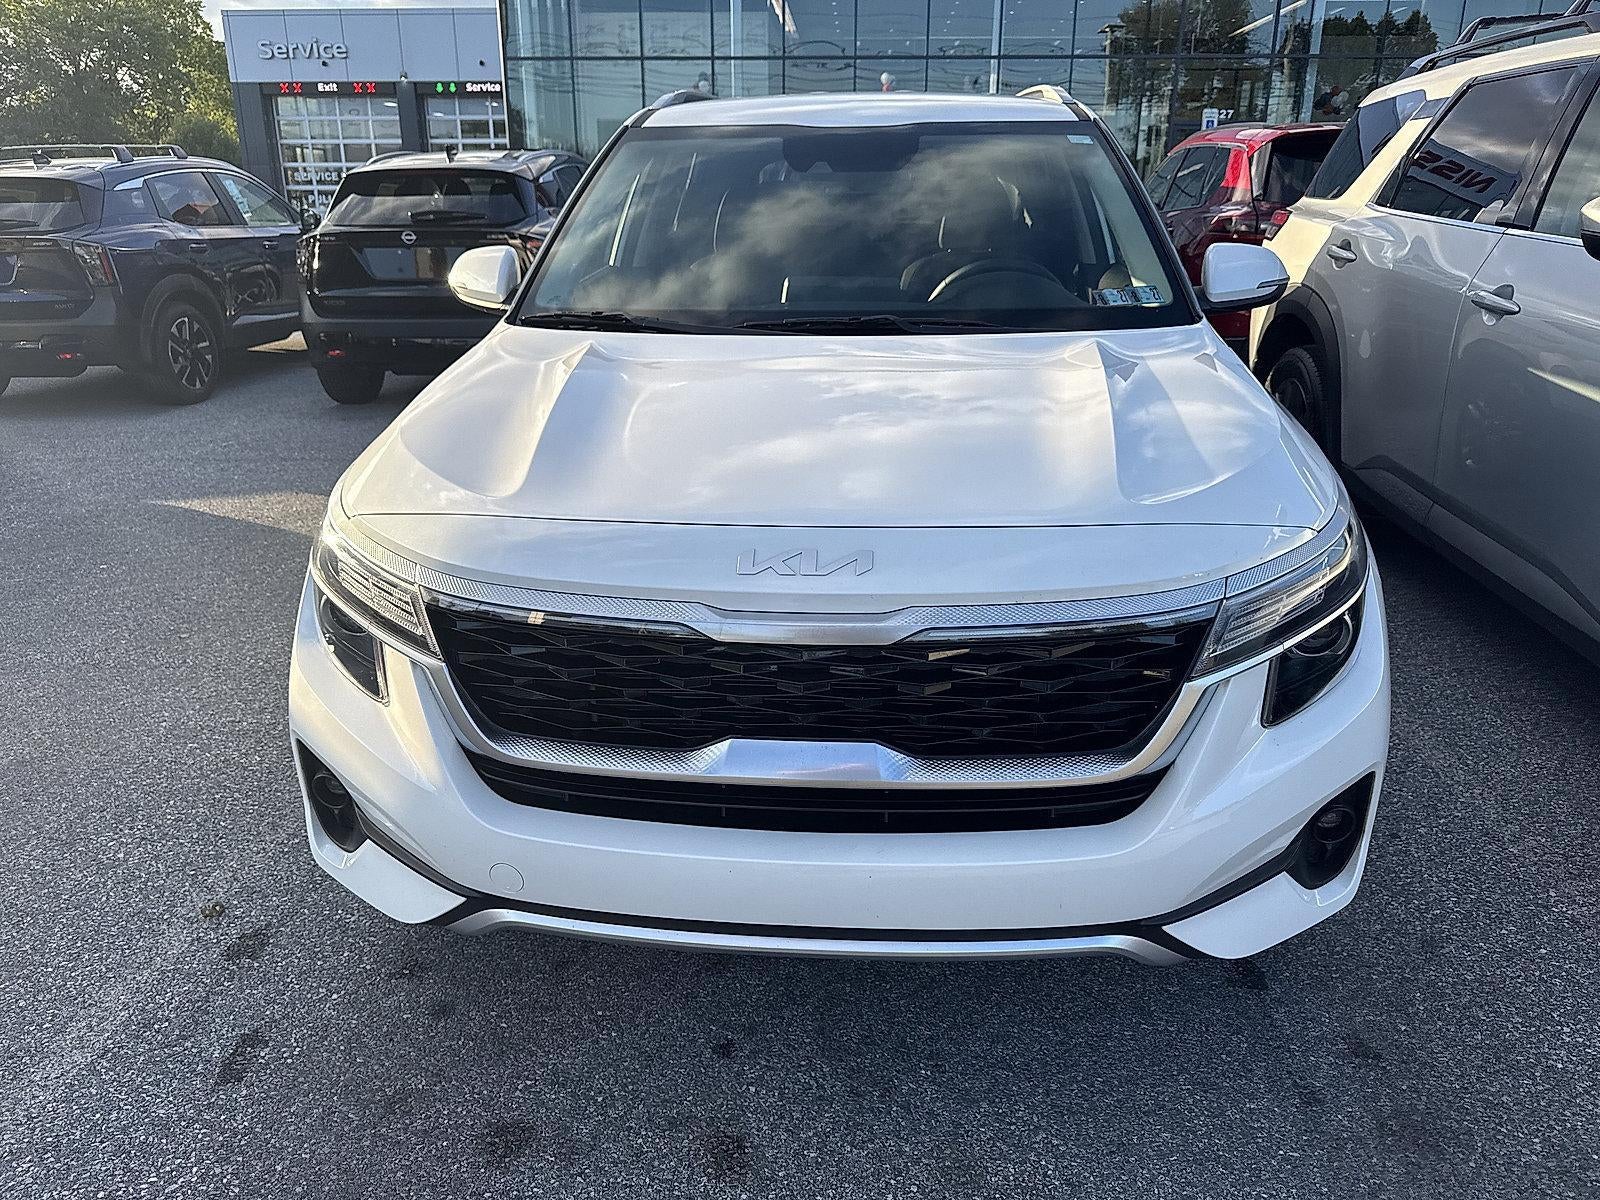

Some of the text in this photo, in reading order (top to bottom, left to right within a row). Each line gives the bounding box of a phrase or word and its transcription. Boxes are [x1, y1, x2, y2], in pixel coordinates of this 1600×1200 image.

[257, 37, 348, 60] Service
[317, 82, 338, 92] Exit
[465, 82, 501, 92] Service
[1219, 109, 1234, 119] 27
[293, 171, 339, 181] SERVICE
[736, 548, 875, 577] KIA
